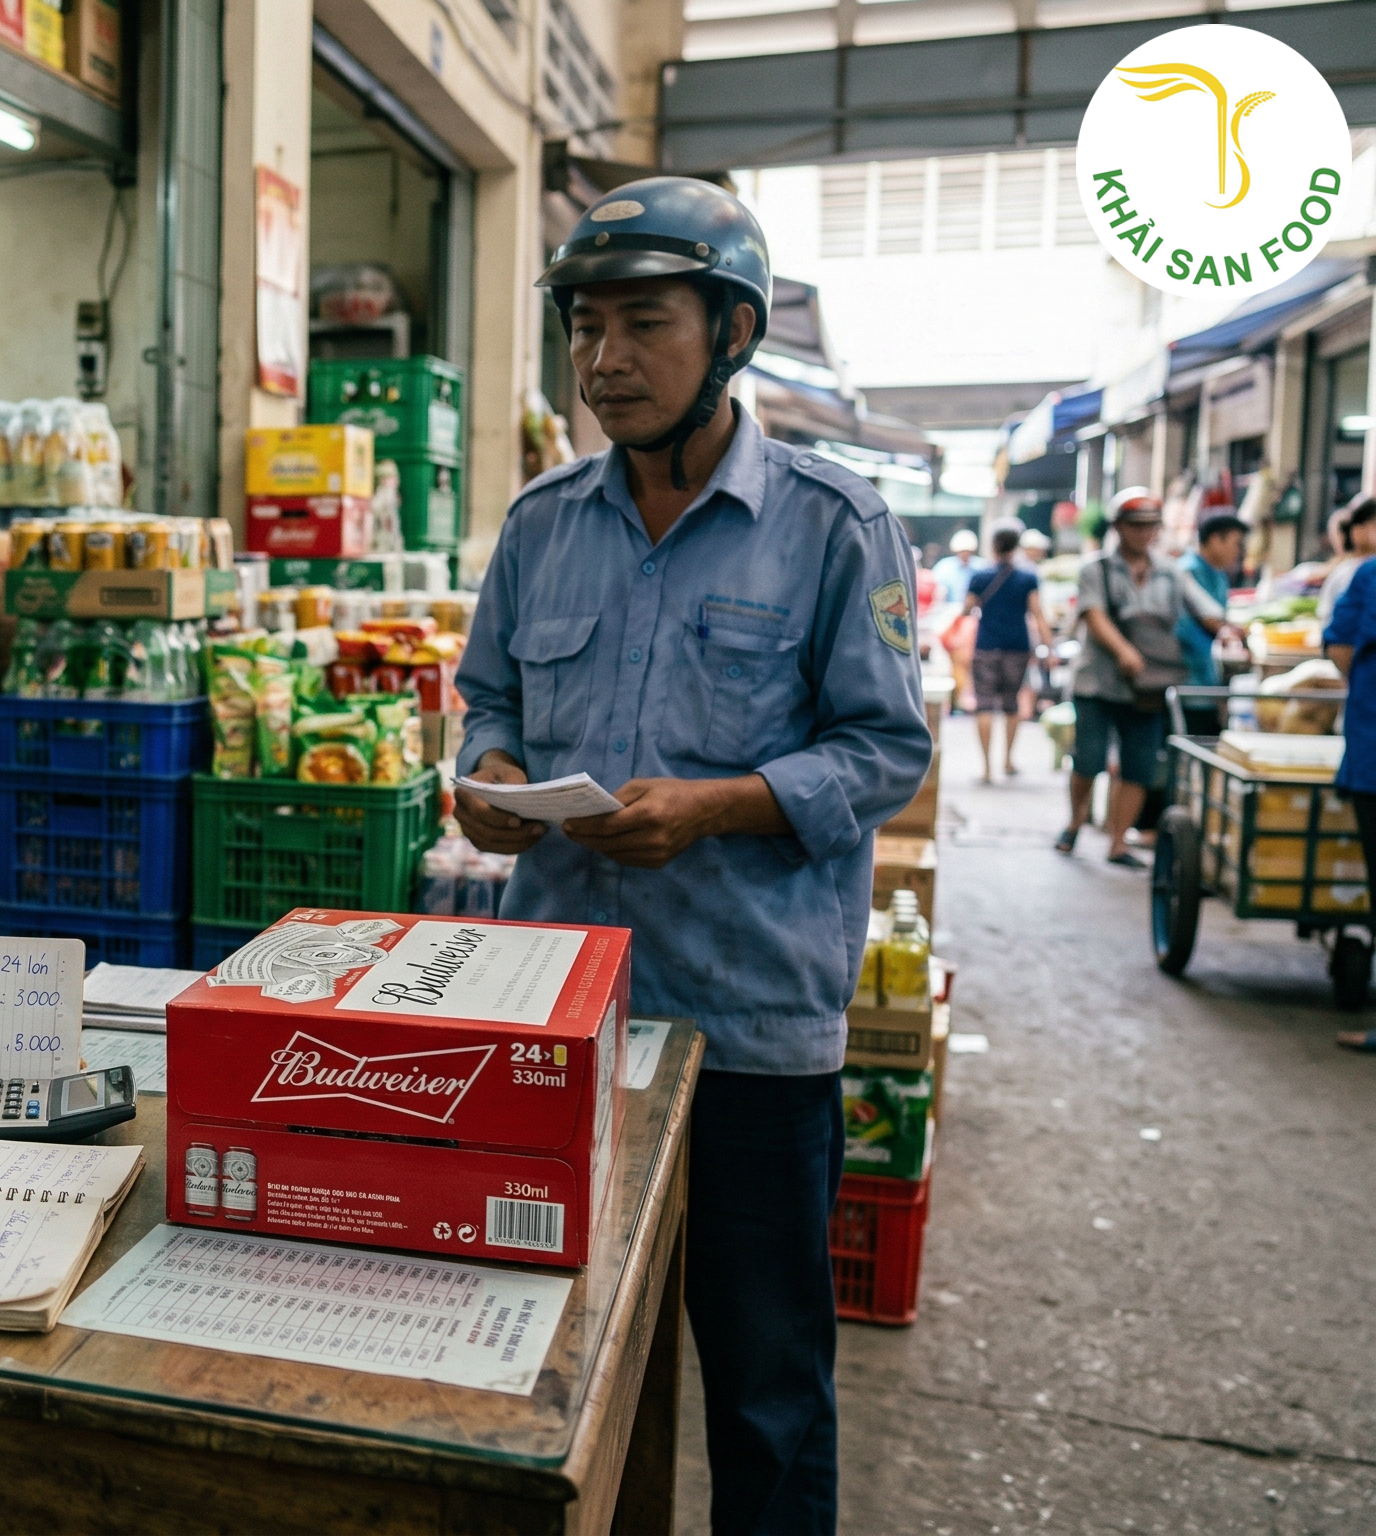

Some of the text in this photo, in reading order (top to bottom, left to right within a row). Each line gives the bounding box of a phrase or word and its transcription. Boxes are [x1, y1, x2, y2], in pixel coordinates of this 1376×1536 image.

[0, 954, 22, 974] 24
[371, 928, 487, 1006] Budweiser
[510, 1042, 543, 1064] 24
[270, 1049, 466, 1096] Budweiser
[512, 1069, 566, 1088] 330ml
[504, 1181, 549, 1199] 330ml
